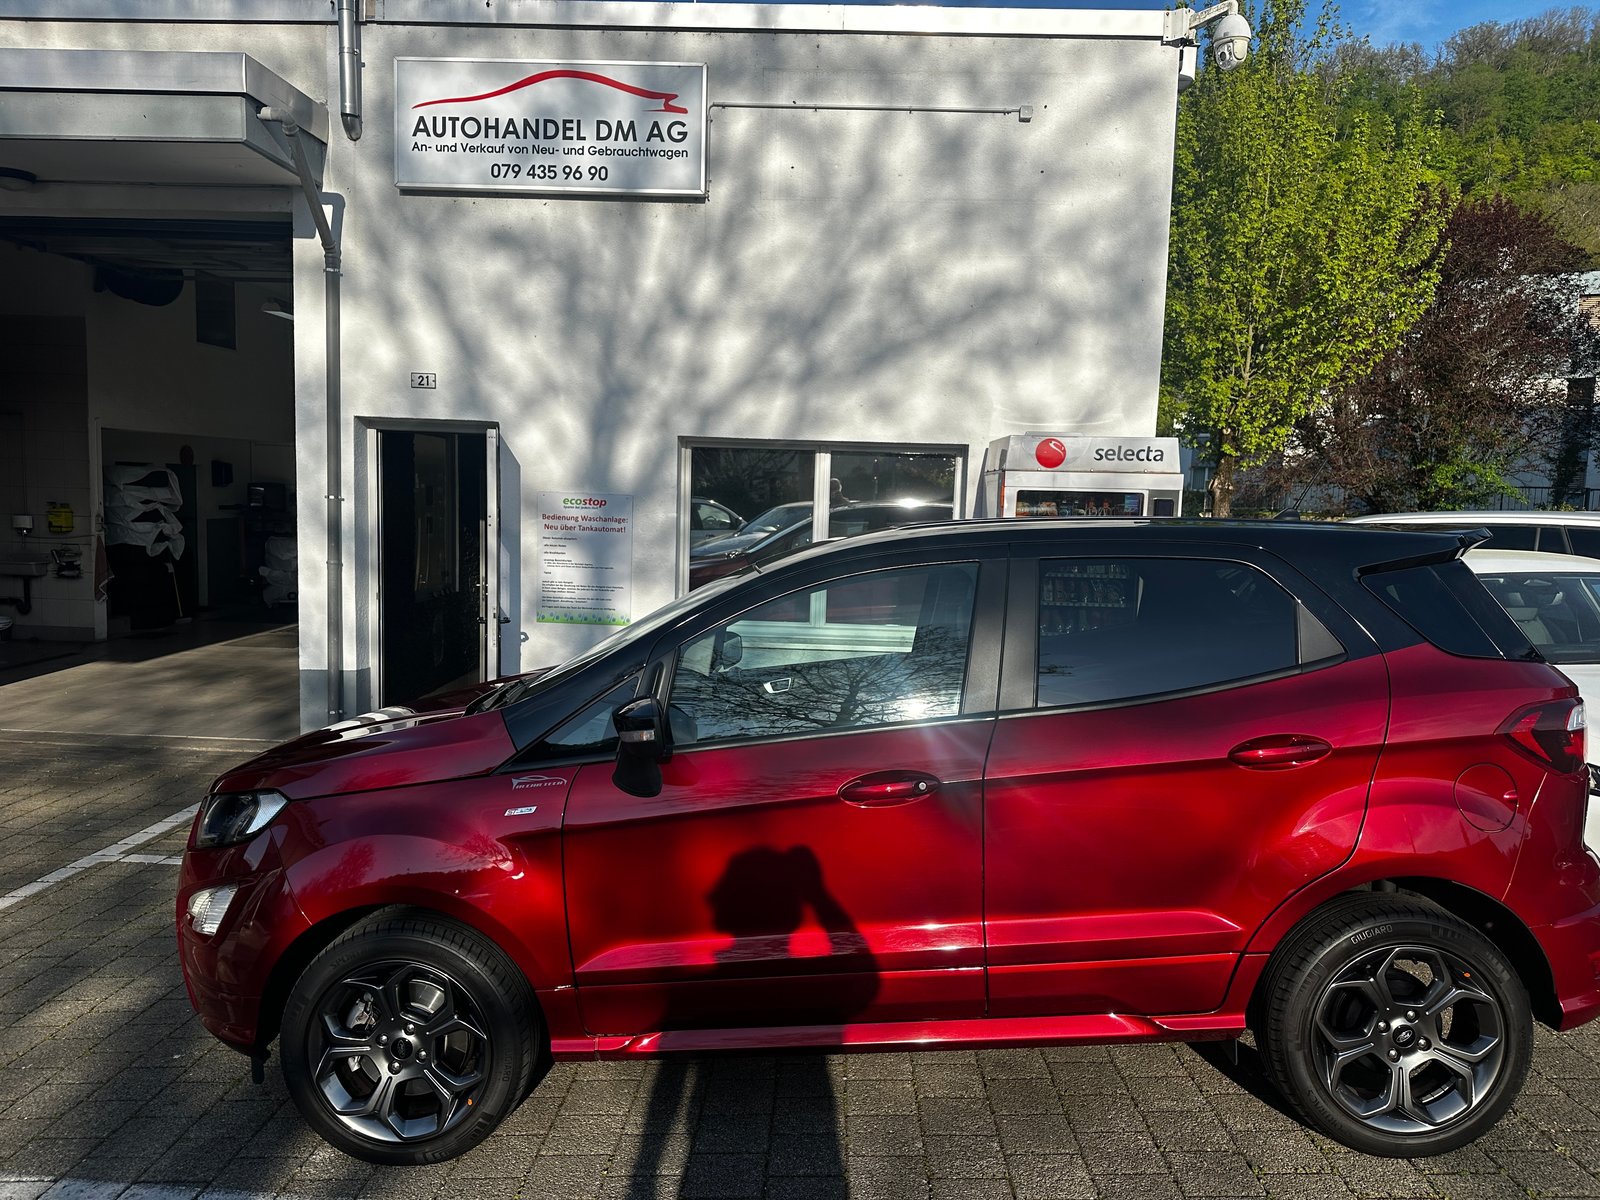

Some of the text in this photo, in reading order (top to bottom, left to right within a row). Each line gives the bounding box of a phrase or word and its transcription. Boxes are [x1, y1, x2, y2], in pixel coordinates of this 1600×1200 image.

[412, 115, 689, 143] AUTOHANDEL DM AG
[411, 142, 689, 160] An- und Verkauf von Neu- und Gebrauchtwagen
[490, 163, 609, 181] 079 435 96 90
[417, 375, 430, 386] 21
[1093, 445, 1164, 462] selecta
[562, 498, 607, 508] ecostop
[542, 514, 629, 525] Bedienung Waschanlage:
[544, 523, 559, 531] Neu
[578, 525, 626, 533] Tankautomat!
[1350, 924, 1393, 945] GIUGIARO
